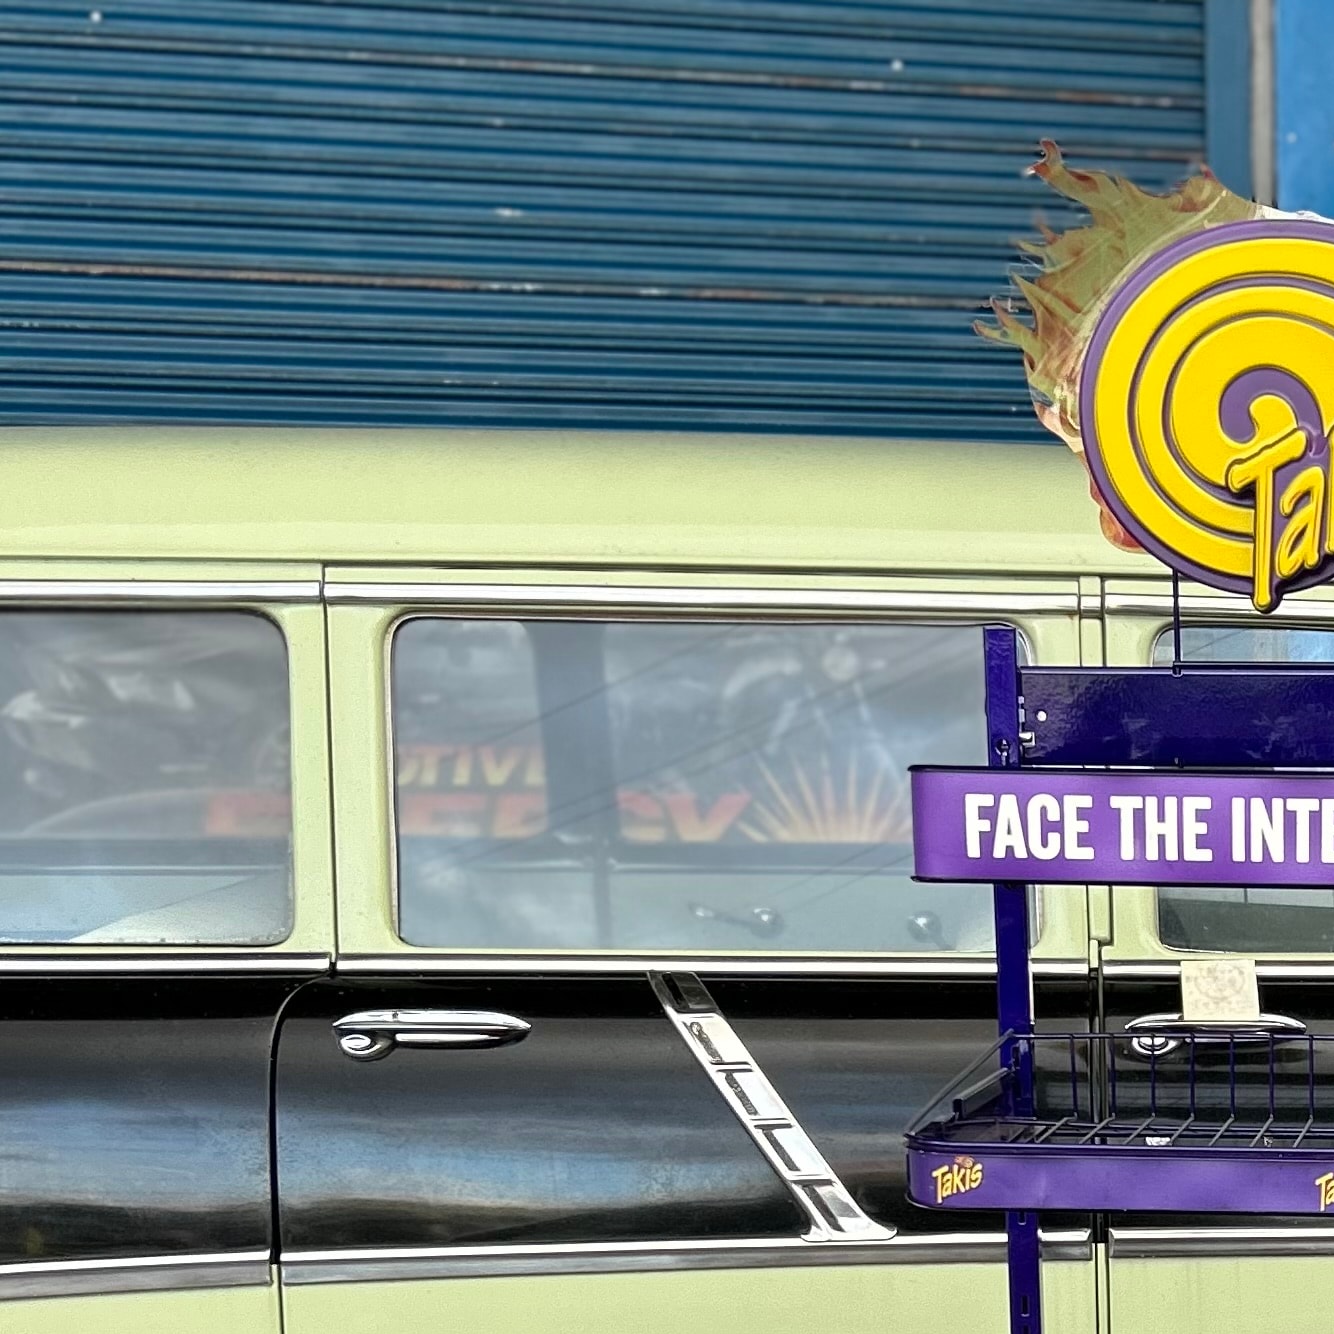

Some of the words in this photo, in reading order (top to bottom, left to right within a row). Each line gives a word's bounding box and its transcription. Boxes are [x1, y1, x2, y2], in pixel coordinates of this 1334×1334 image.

[964, 792, 1095, 860] FACE
[1109, 795, 1213, 862] THE
[932, 1160, 983, 1203] Takis
